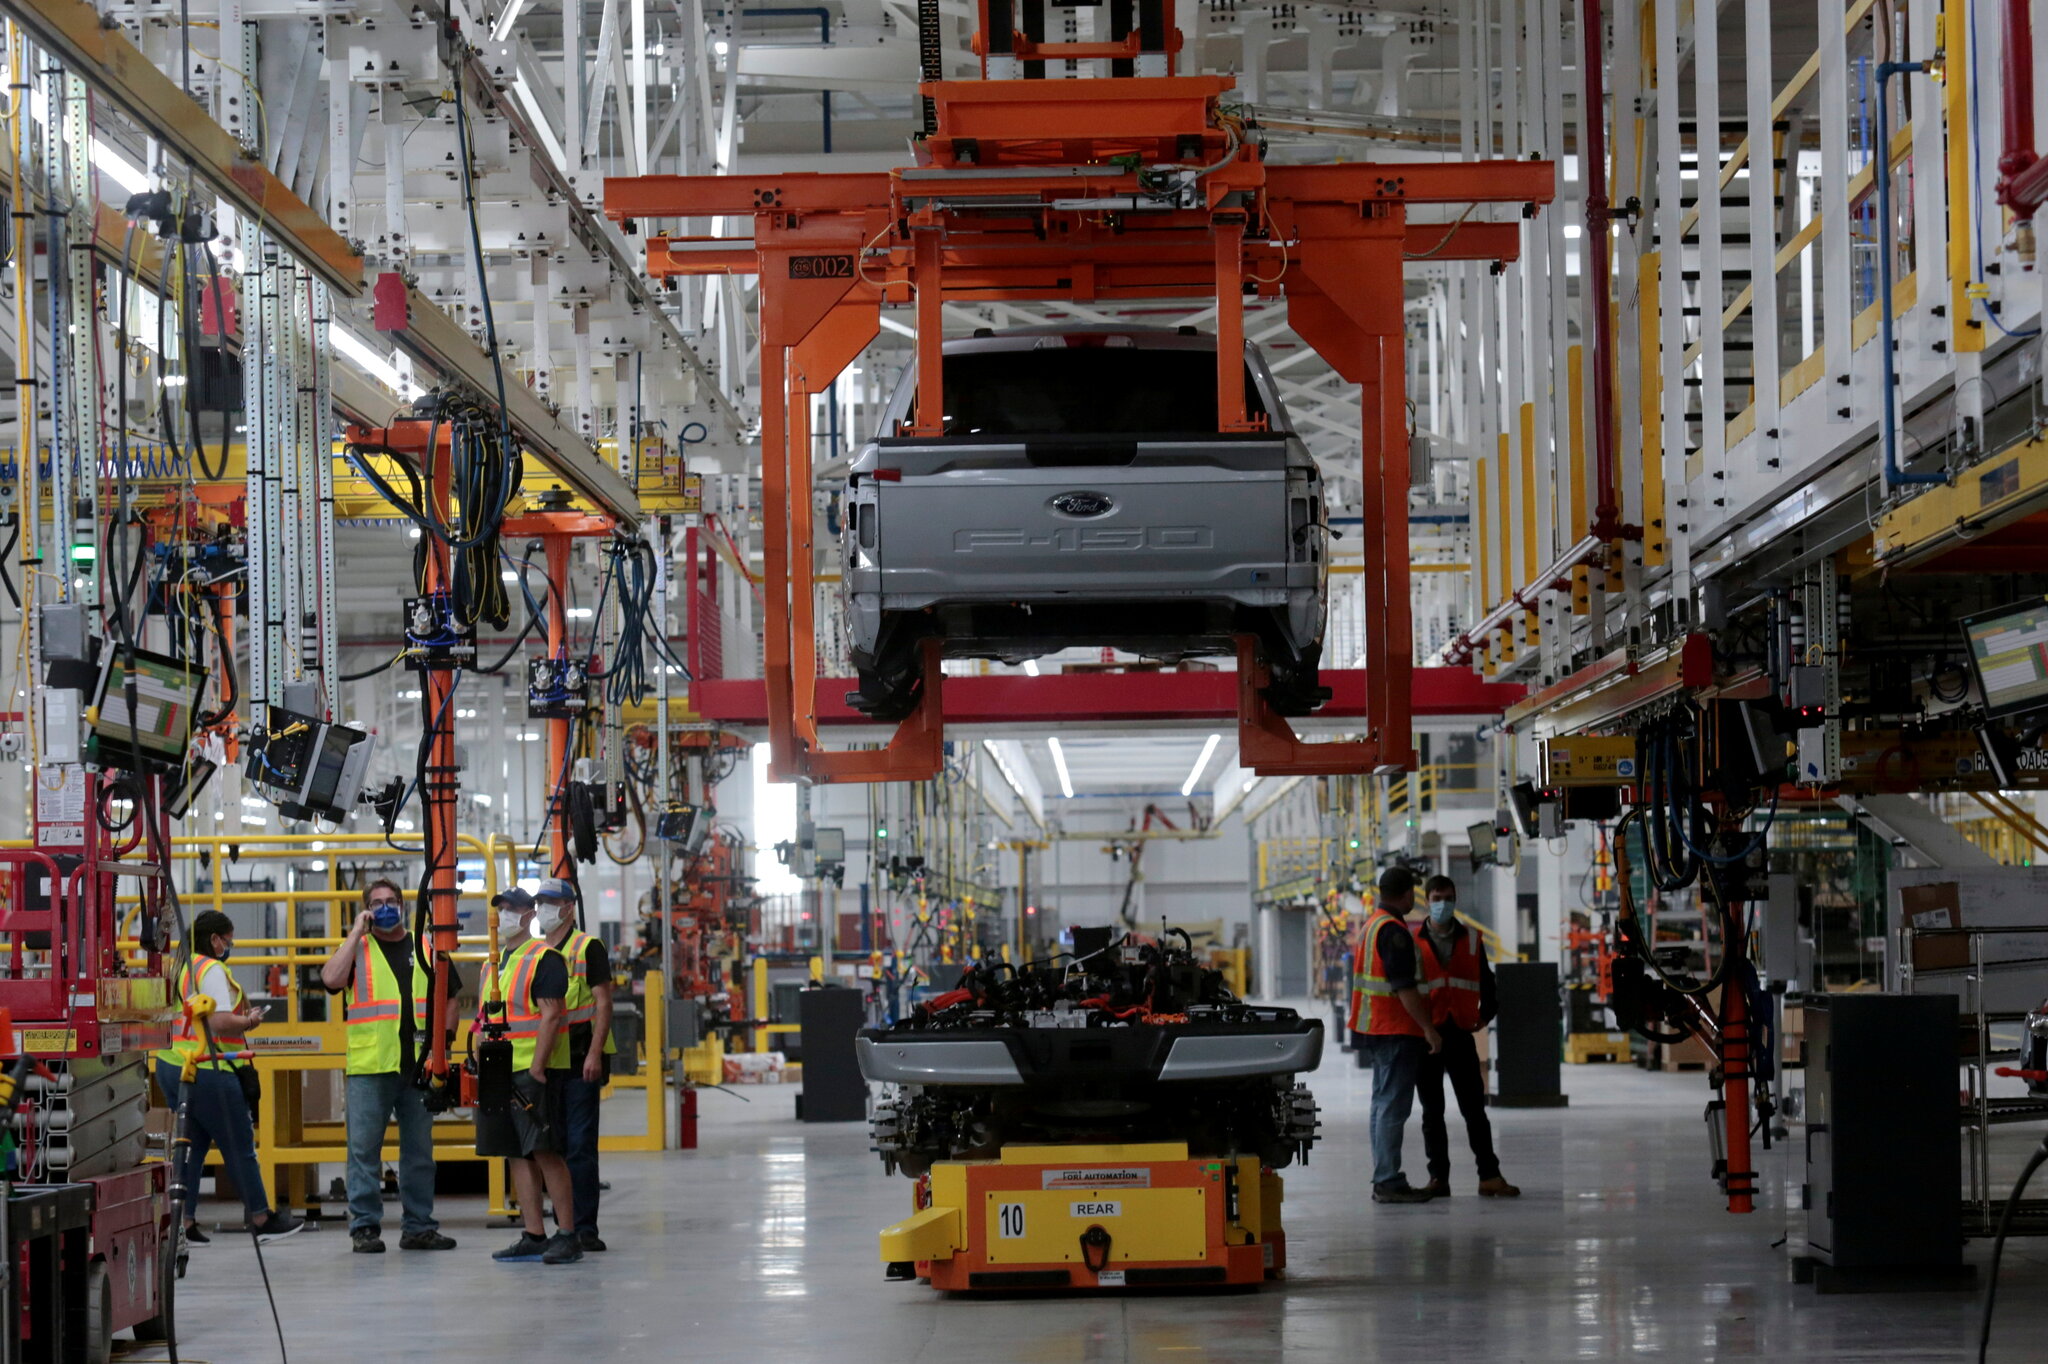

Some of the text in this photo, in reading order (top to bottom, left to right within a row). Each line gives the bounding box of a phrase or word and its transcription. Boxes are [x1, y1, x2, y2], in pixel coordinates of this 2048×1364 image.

[813, 257, 850, 276] 002
[1066, 498, 1099, 512] Ford
[953, 525, 1214, 553] F-150
[1077, 1203, 1114, 1215] REAR
[1001, 1204, 1023, 1236] 10
